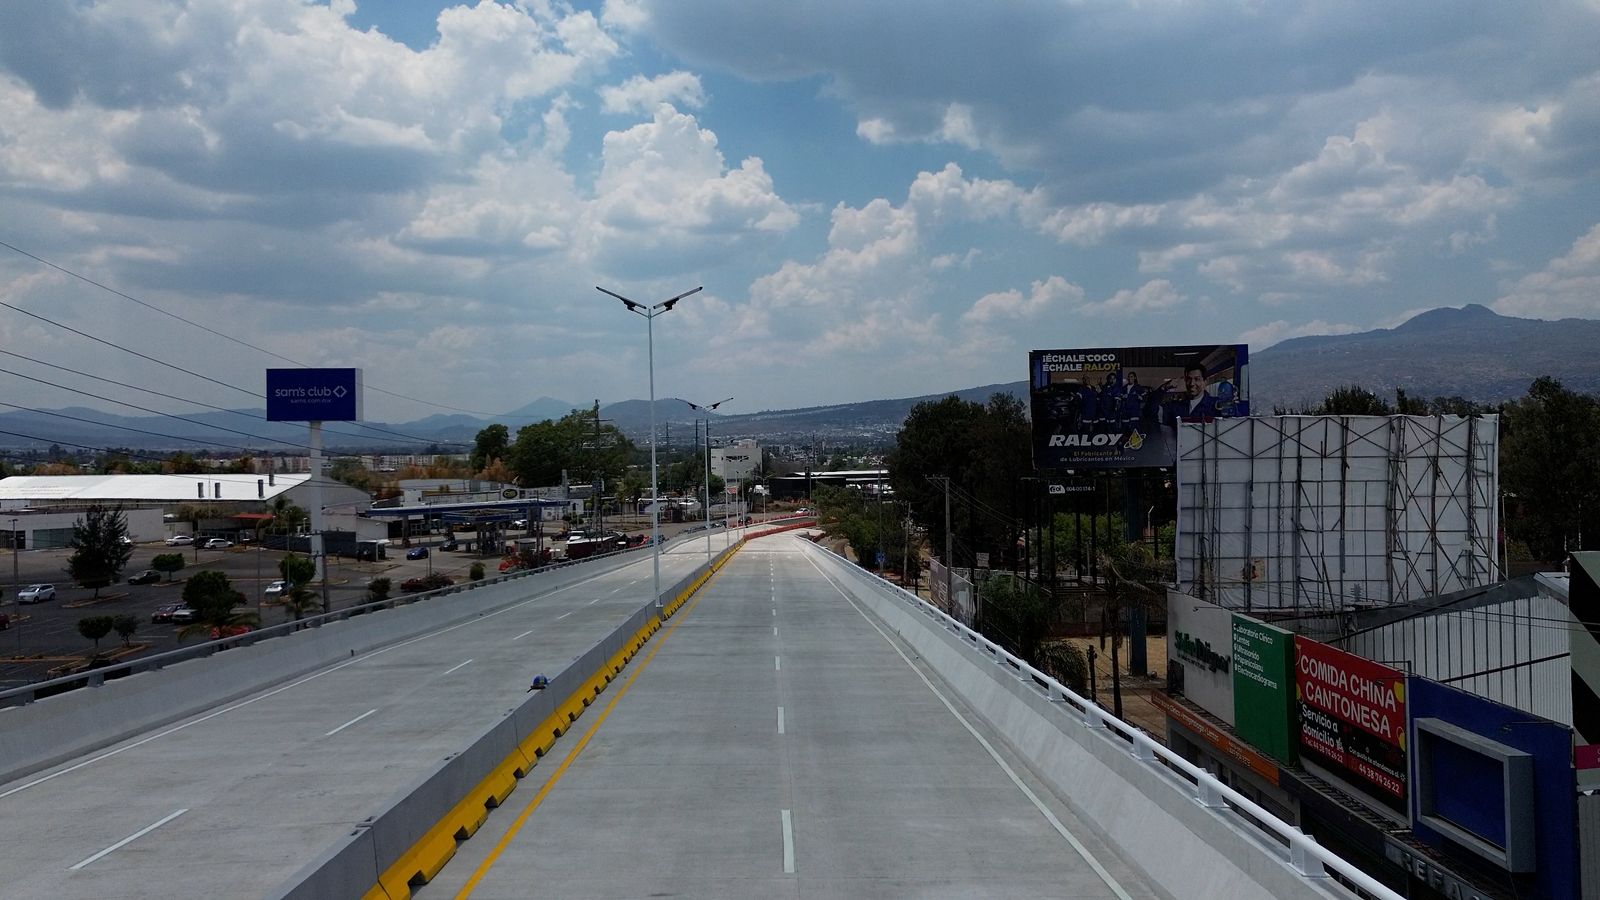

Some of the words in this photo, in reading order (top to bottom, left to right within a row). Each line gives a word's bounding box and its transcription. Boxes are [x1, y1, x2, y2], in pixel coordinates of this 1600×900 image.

[1042, 363, 1082, 372] ÉCHALE
[275, 386, 306, 397] sam's
[307, 386, 332, 397] club
[1048, 434, 1124, 446] RALOY
[1300, 654, 1348, 692] COMIDA
[1350, 674, 1396, 713] CHINA
[1302, 704, 1332, 730] Servicio
[1332, 722, 1338, 734] a
[1305, 680, 1392, 738] CANTONESA
[1302, 720, 1334, 748] domicilio
[1366, 767, 1374, 779] 38
[1391, 782, 1400, 794] 22
